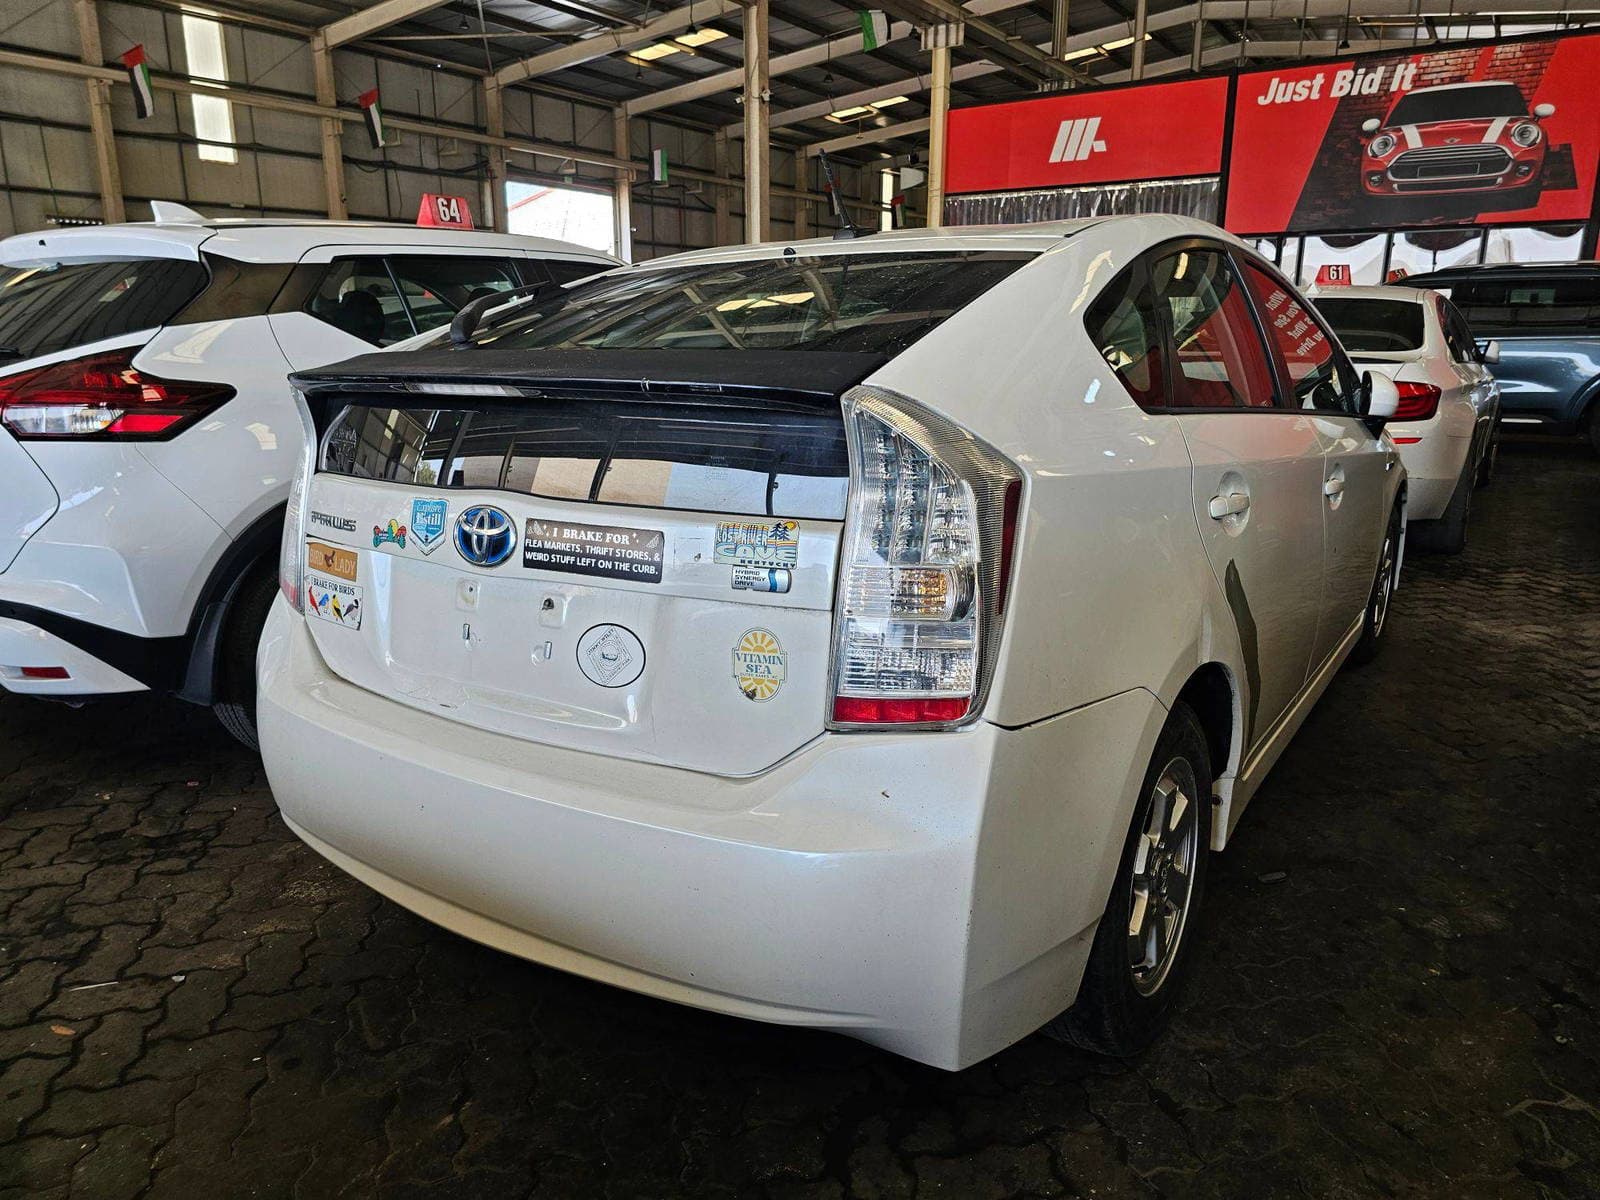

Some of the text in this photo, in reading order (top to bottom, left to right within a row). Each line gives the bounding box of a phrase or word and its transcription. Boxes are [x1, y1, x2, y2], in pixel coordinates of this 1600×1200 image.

[1257, 63, 1417, 105] Just Bid It
[437, 197, 461, 223] 64
[1329, 265, 1344, 280] 61
[552, 527, 630, 545] I BRAKE FOR
[716, 527, 769, 547] LOST RIVER
[525, 538, 542, 549] FLEA
[585, 544, 614, 557] THRIFT
[653, 552, 661, 562] &
[715, 541, 797, 562] CAVE
[334, 556, 356, 577] LADY
[525, 551, 658, 575] WEIRD STUFF LEFT ON THE CURB.
[740, 559, 796, 568] KENTUCKY
[313, 577, 328, 590] BRAKE
[328, 581, 338, 592] FOR
[338, 584, 355, 596] BIRDS
[735, 652, 783, 666] VITAMIN
[745, 663, 772, 675] SEA
